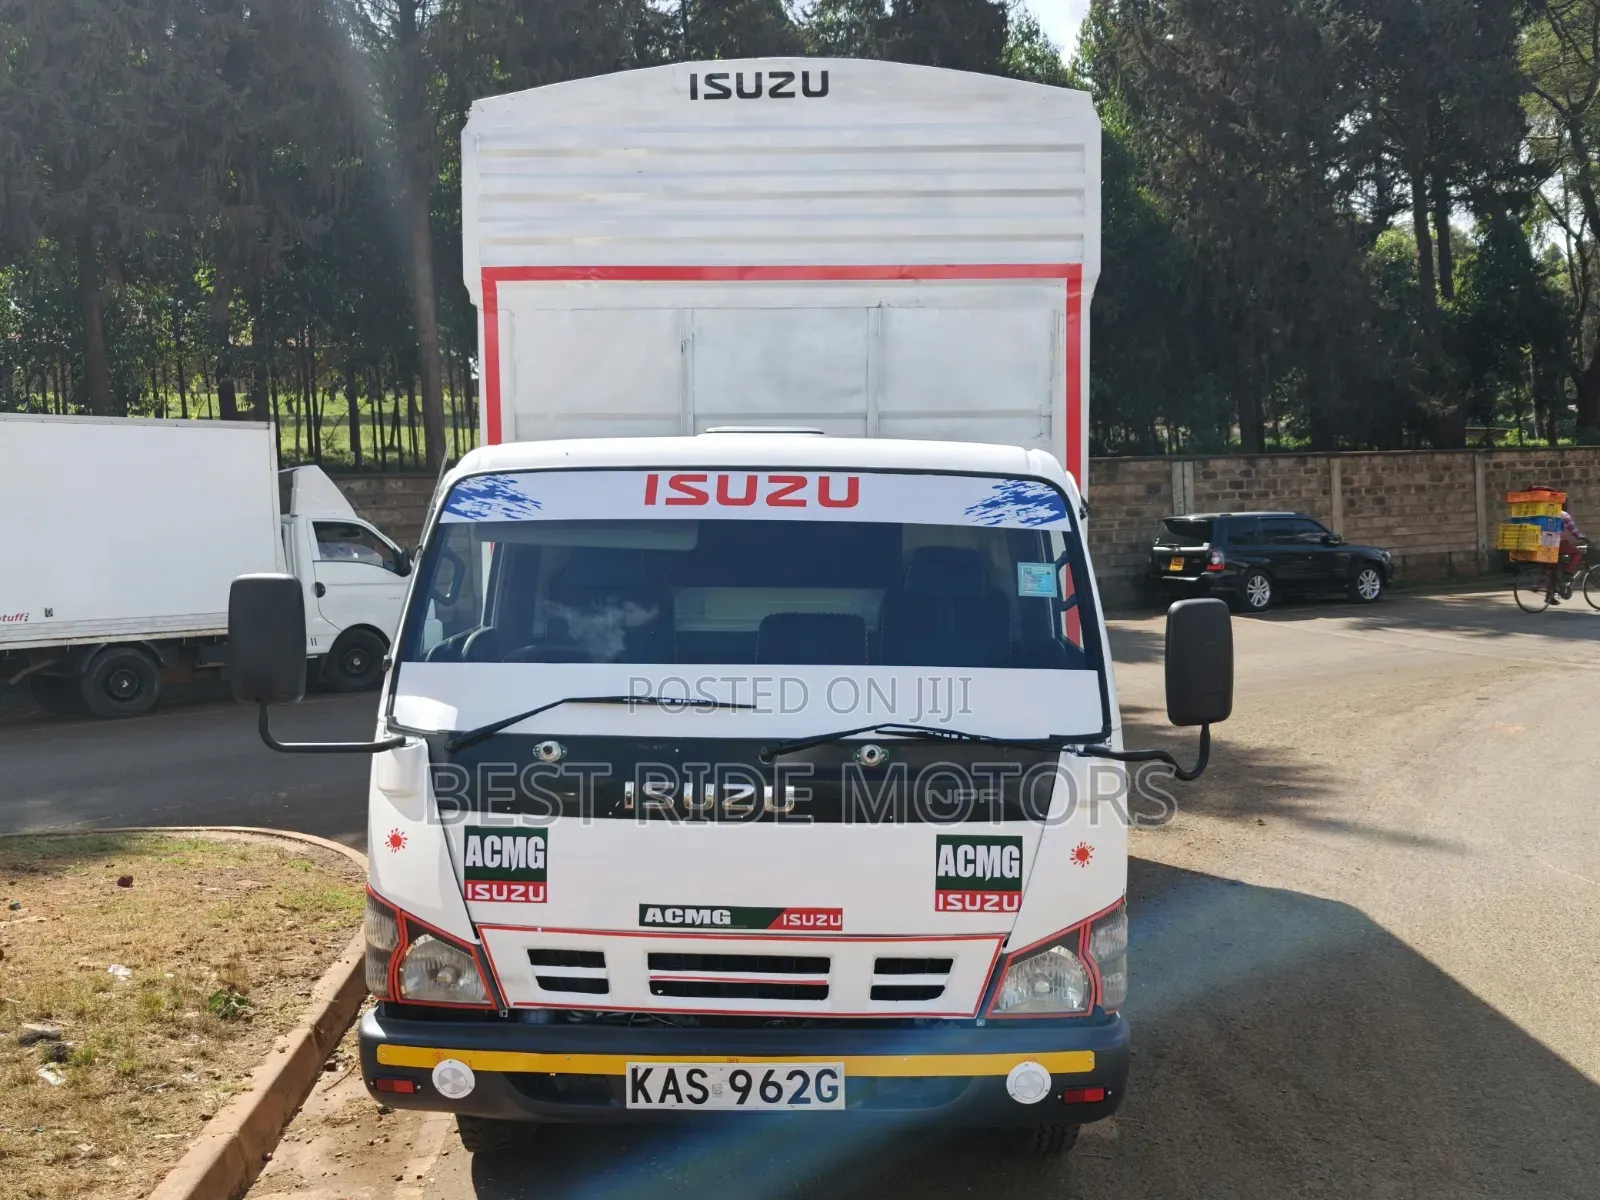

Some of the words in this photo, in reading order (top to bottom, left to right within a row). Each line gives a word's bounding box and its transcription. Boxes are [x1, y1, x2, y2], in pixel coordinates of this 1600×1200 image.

[689, 70, 830, 101] ISUZU
[643, 473, 860, 509] ISUZU
[623, 781, 796, 813] ISUZU
[465, 834, 546, 872] ACMG
[936, 844, 1021, 882] ACMG
[466, 883, 545, 902] ISUZU
[938, 893, 1020, 911] ISUZU
[644, 907, 732, 926] ACMG
[782, 913, 842, 927] ISUZU
[631, 1068, 709, 1105] KAS
[728, 1068, 839, 1105] 962G
